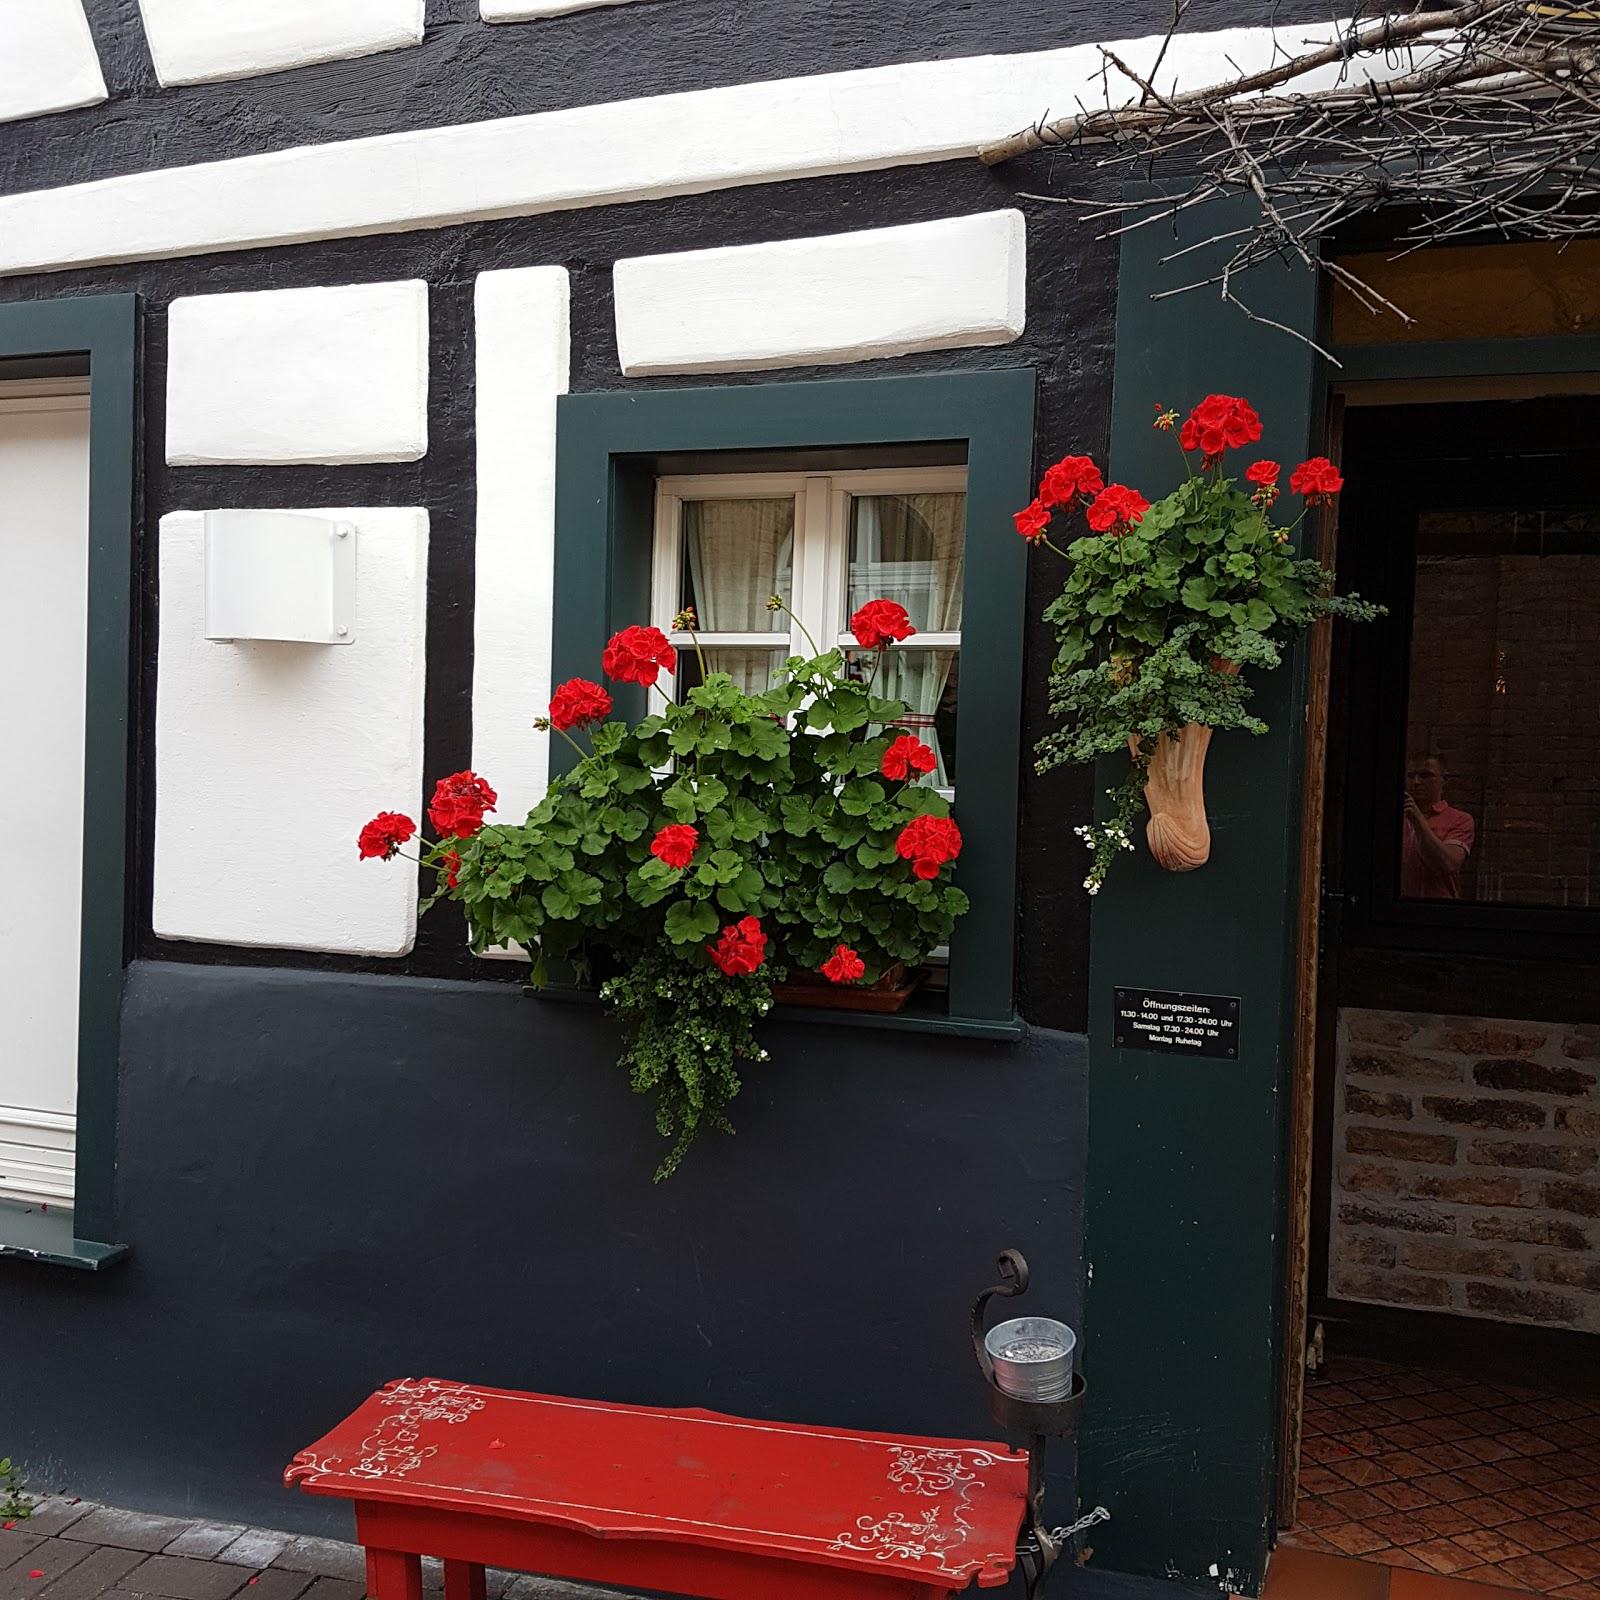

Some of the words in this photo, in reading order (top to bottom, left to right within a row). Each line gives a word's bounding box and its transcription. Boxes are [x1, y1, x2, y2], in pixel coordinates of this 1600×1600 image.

[1142, 998, 1211, 1014] Öffnungszeiten:
[1132, 1021, 1161, 1032] Samstag
[1207, 1029, 1219, 1037] Uhr
[1220, 1019, 1233, 1027] Uhr
[1148, 1034, 1173, 1044] Montag
[1175, 1037, 1202, 1047] Ruhetag
